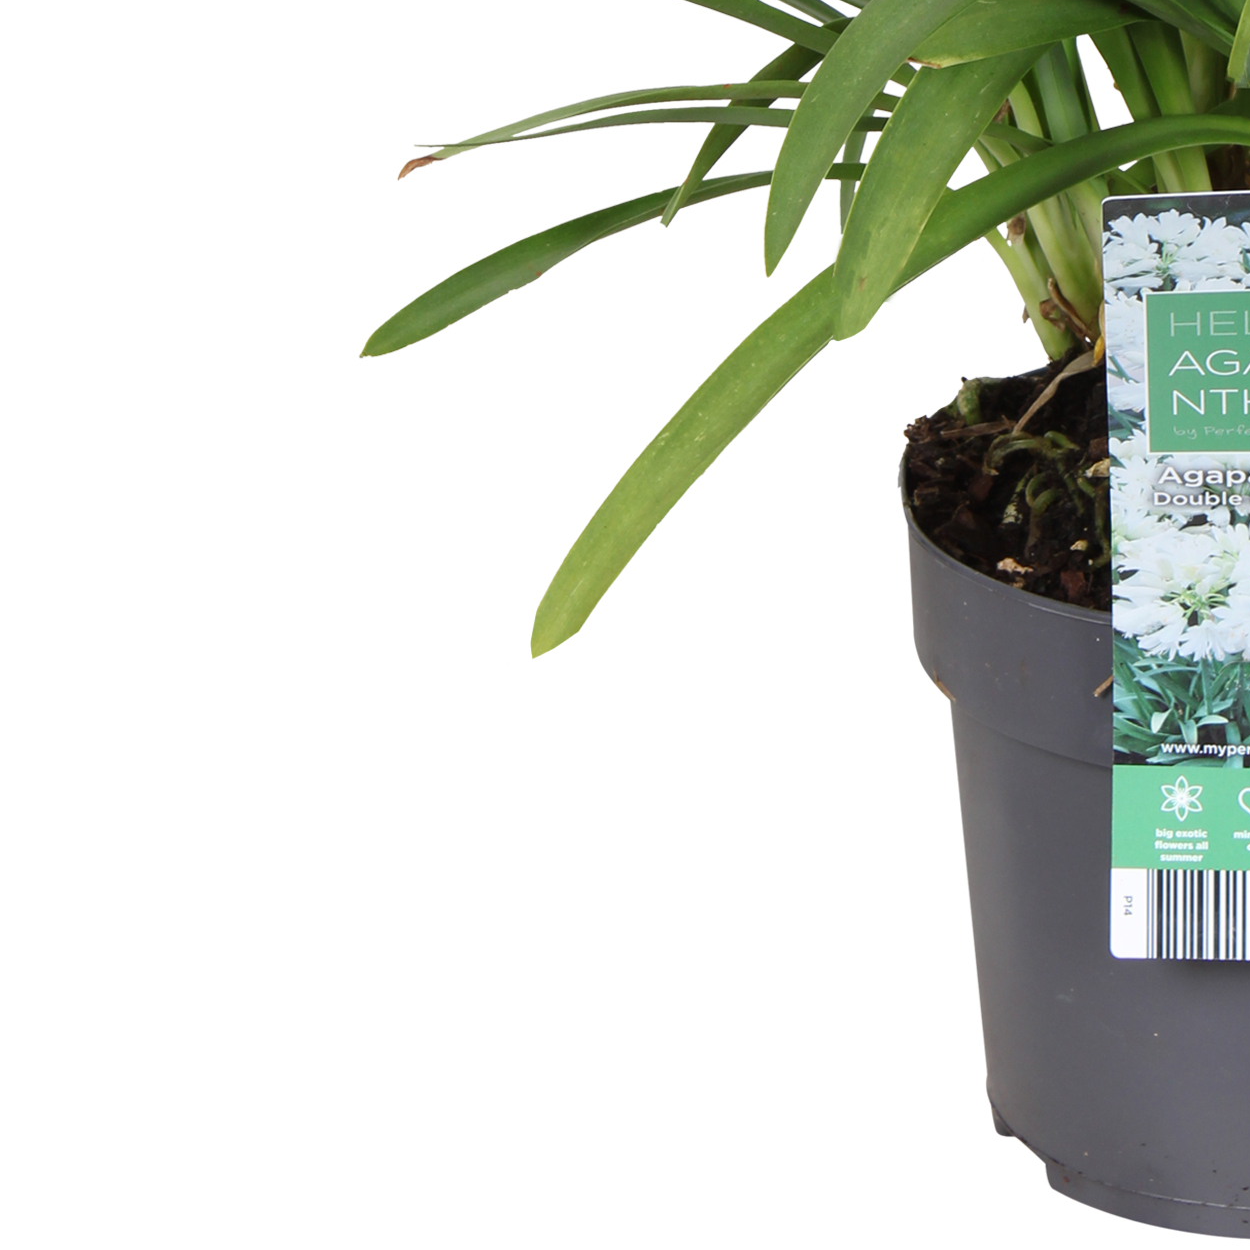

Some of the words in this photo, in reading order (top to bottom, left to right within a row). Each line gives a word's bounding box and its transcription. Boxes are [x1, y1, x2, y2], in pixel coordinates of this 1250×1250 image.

[1173, 426, 1198, 440] by
[1154, 492, 1243, 506] Double
[1155, 828, 1173, 840] big
[1175, 828, 1208, 838] exotic
[1154, 840, 1193, 851] flowers
[1195, 840, 1209, 851] all
[1160, 852, 1204, 862] summer
[1123, 895, 1133, 916] P14
